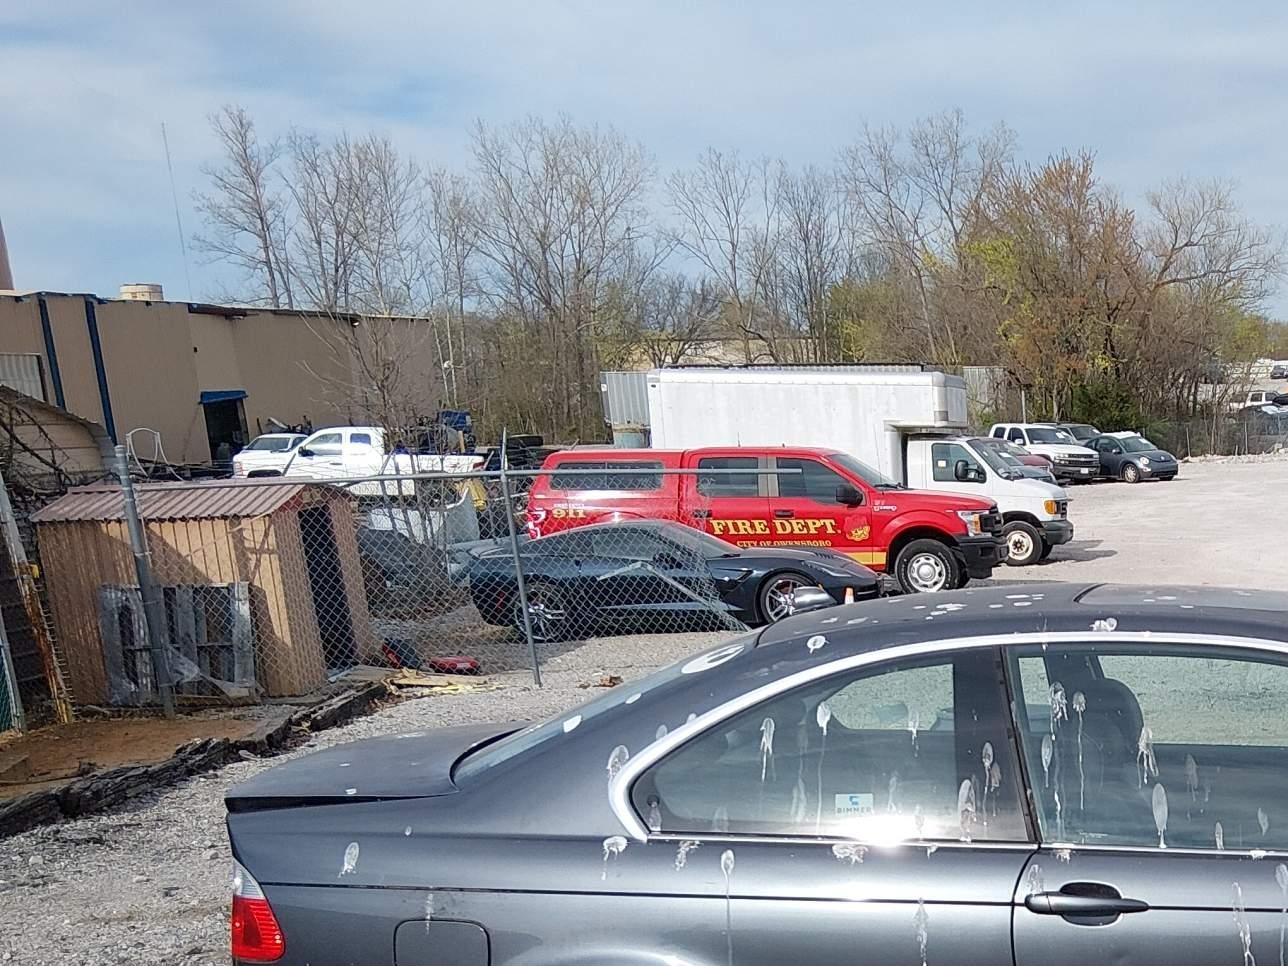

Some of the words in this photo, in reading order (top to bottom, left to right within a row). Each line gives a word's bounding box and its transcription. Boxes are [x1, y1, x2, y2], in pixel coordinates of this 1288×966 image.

[552, 508, 586, 519] 911
[710, 519, 770, 535] FIRE
[772, 519, 841, 535] DEPT.
